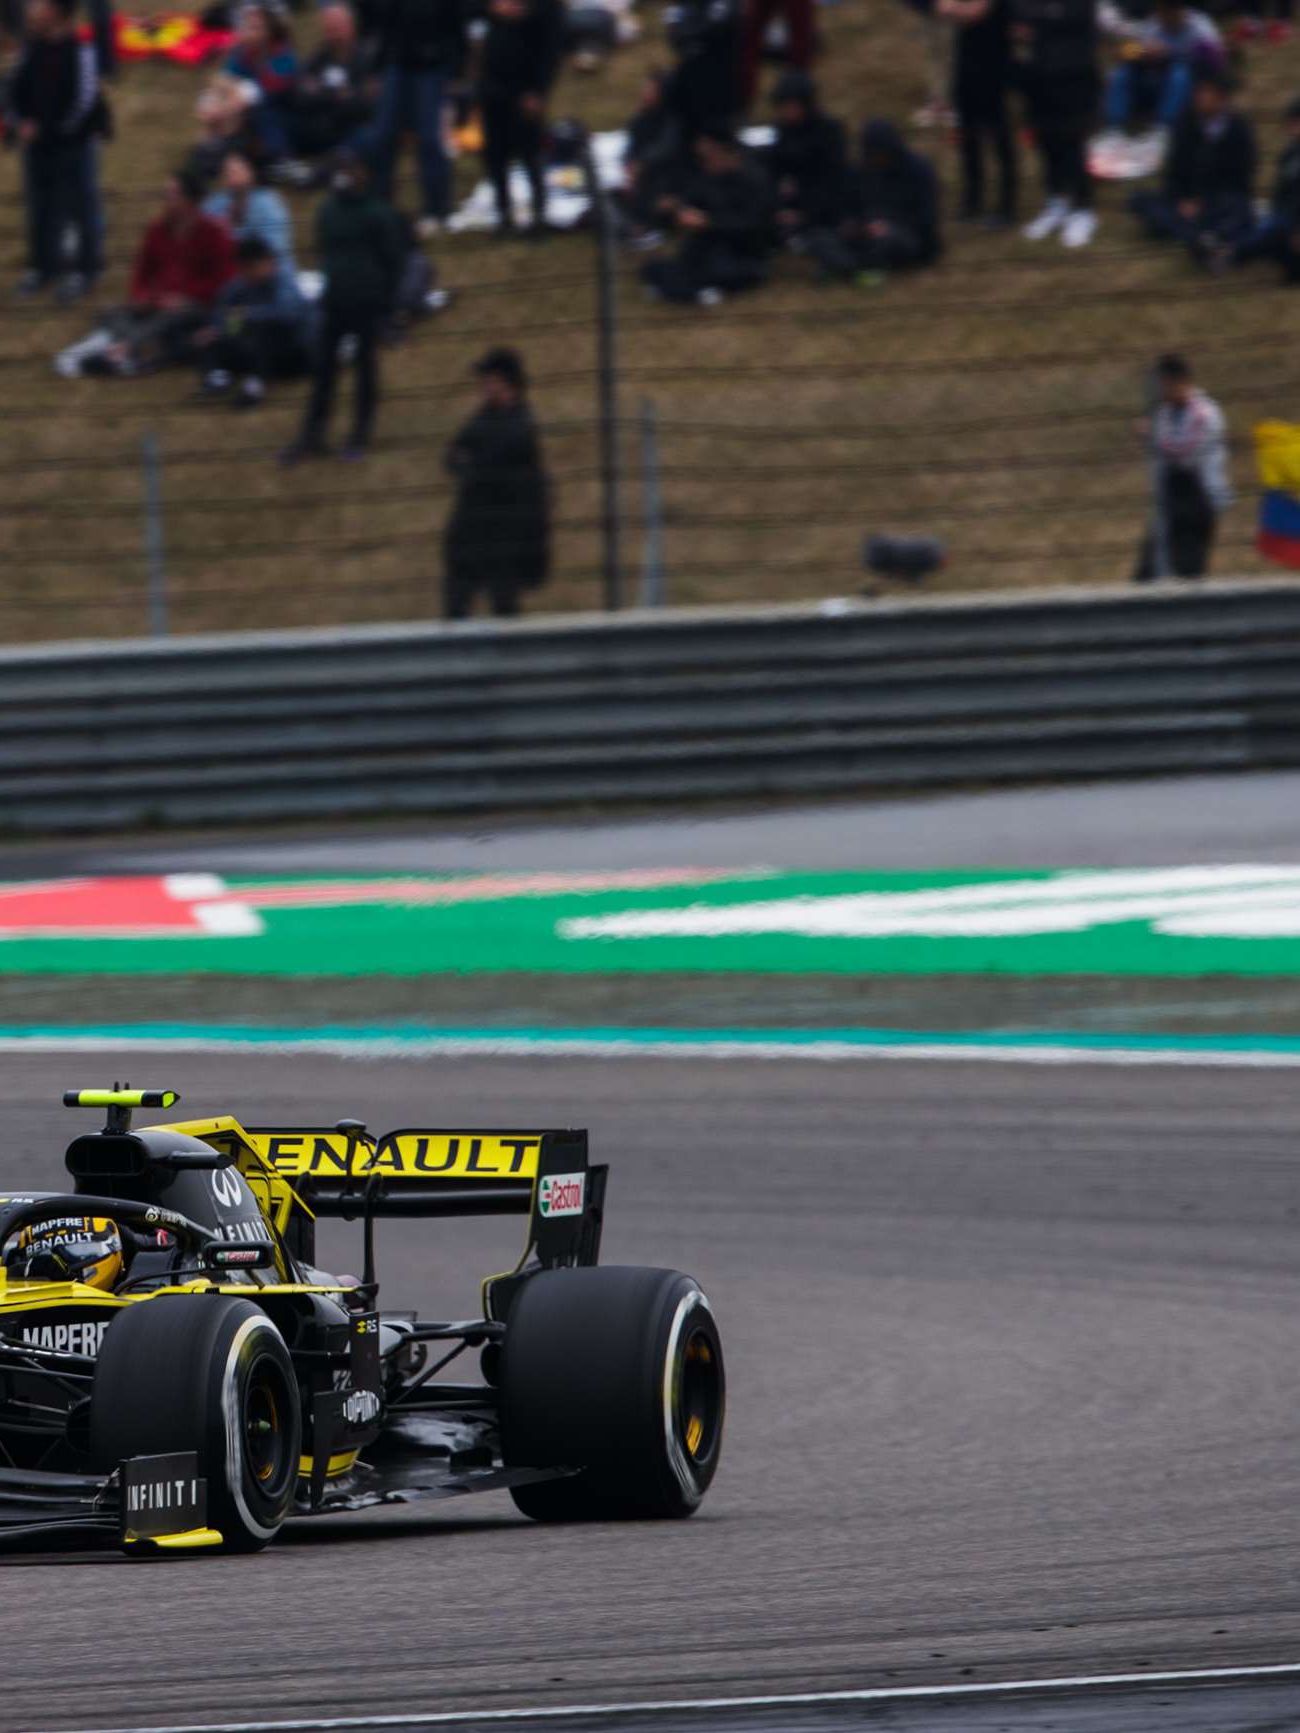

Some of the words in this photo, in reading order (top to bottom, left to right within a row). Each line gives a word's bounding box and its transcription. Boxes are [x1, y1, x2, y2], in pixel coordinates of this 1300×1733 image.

[266, 1138, 539, 1173] ENAULT
[551, 1176, 583, 1213] Castrol
[32, 1217, 83, 1235] MAPFRE
[26, 1232, 93, 1254] RENAULT
[127, 1479, 197, 1512] INFINITI
